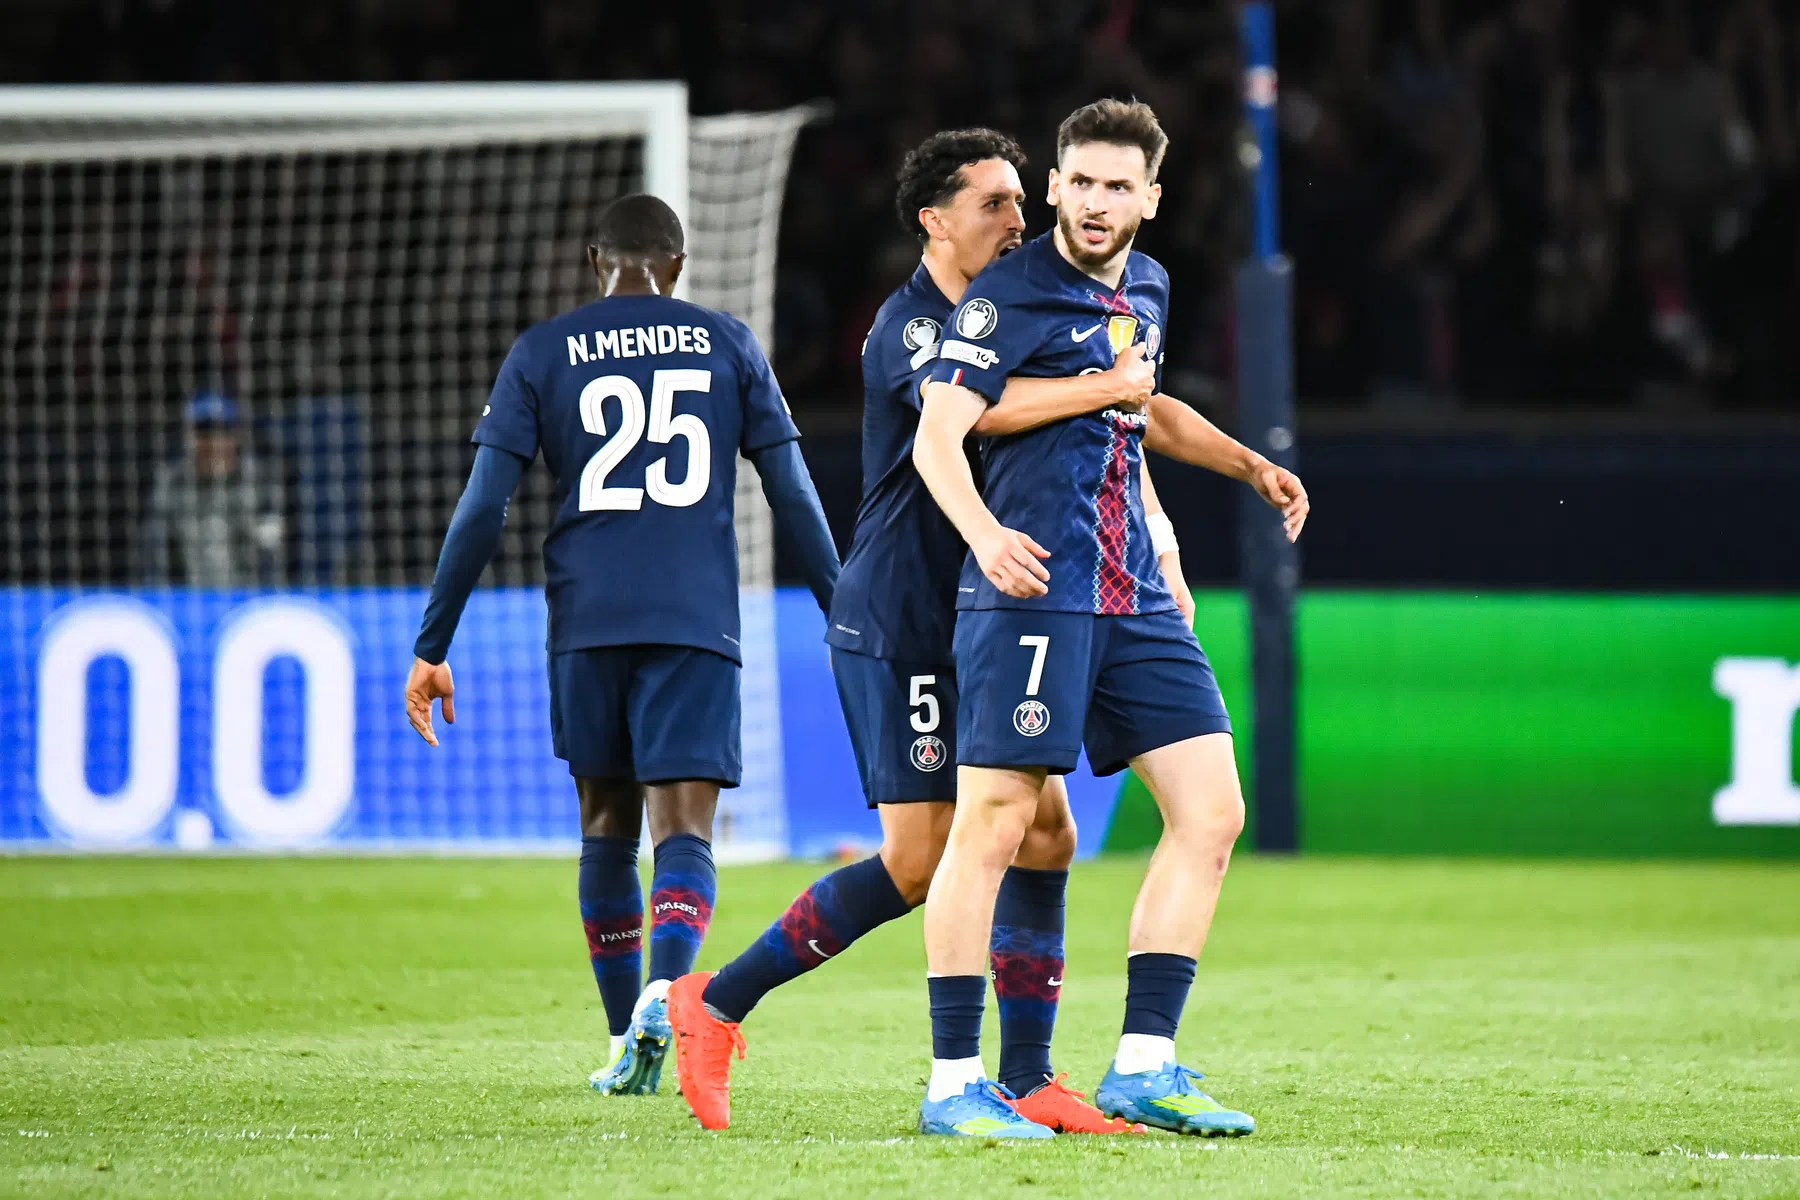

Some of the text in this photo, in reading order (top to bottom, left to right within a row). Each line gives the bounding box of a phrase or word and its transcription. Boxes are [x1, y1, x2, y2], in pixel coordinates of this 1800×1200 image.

[566, 324, 711, 366] N.MENDES
[578, 368, 712, 512] 25
[1018, 635, 1050, 696] 7
[36, 596, 357, 853] 0.0
[909, 674, 940, 733] 5
[1019, 701, 1045, 712] PARIS
[915, 737, 940, 747] PARIS
[654, 901, 698, 916] PARIS
[600, 928, 643, 943] PARIS
